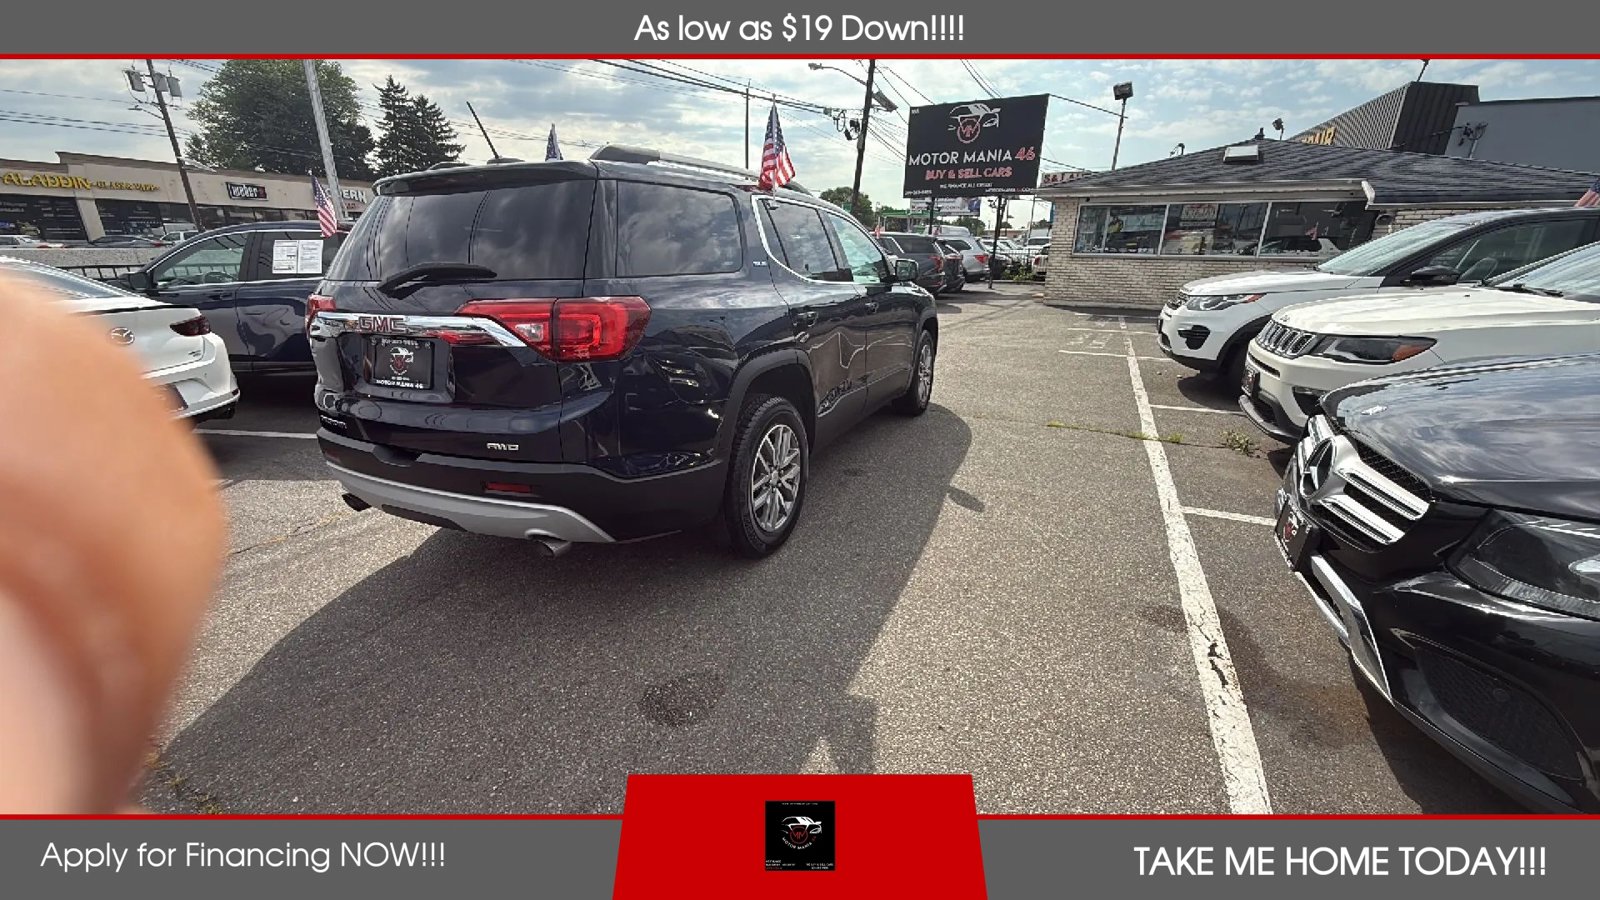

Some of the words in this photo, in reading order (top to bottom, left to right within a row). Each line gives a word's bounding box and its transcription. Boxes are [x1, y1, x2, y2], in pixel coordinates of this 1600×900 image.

[908, 151, 959, 166] MOTOR
[963, 149, 1012, 163] MANIA
[1014, 146, 1036, 161] 46
[3, 172, 92, 190] ALADDIN
[958, 168, 982, 179] SELL
[983, 166, 1013, 178] CARS
[358, 315, 405, 333] GMC
[487, 442, 519, 451] AWD
